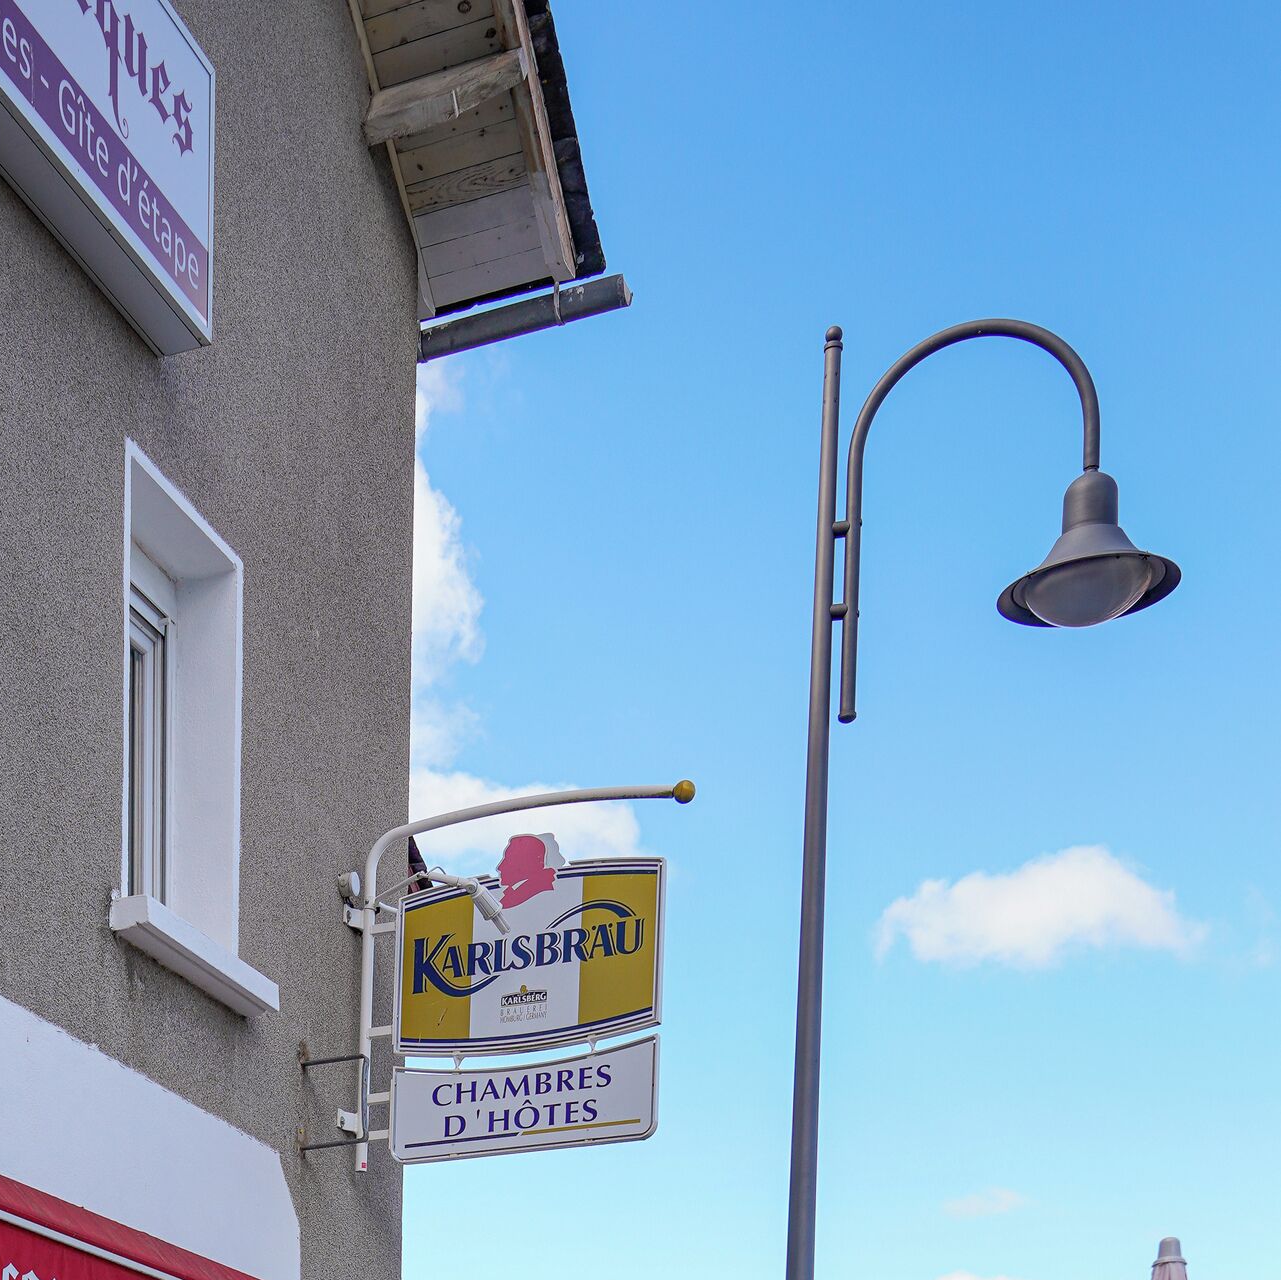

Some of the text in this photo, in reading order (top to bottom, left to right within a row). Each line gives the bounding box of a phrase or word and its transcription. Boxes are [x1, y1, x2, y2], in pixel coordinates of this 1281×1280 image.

[77, 0, 194, 157] ques
[58, 79, 109, 178] Gîte
[117, 156, 199, 291] d'étape
[412, 917, 646, 997] KARLSBRÄU
[501, 992, 547, 1006] KARLSBERG
[431, 1063, 613, 1107] CHAMBRES
[443, 1098, 598, 1138] D'HÔTES
